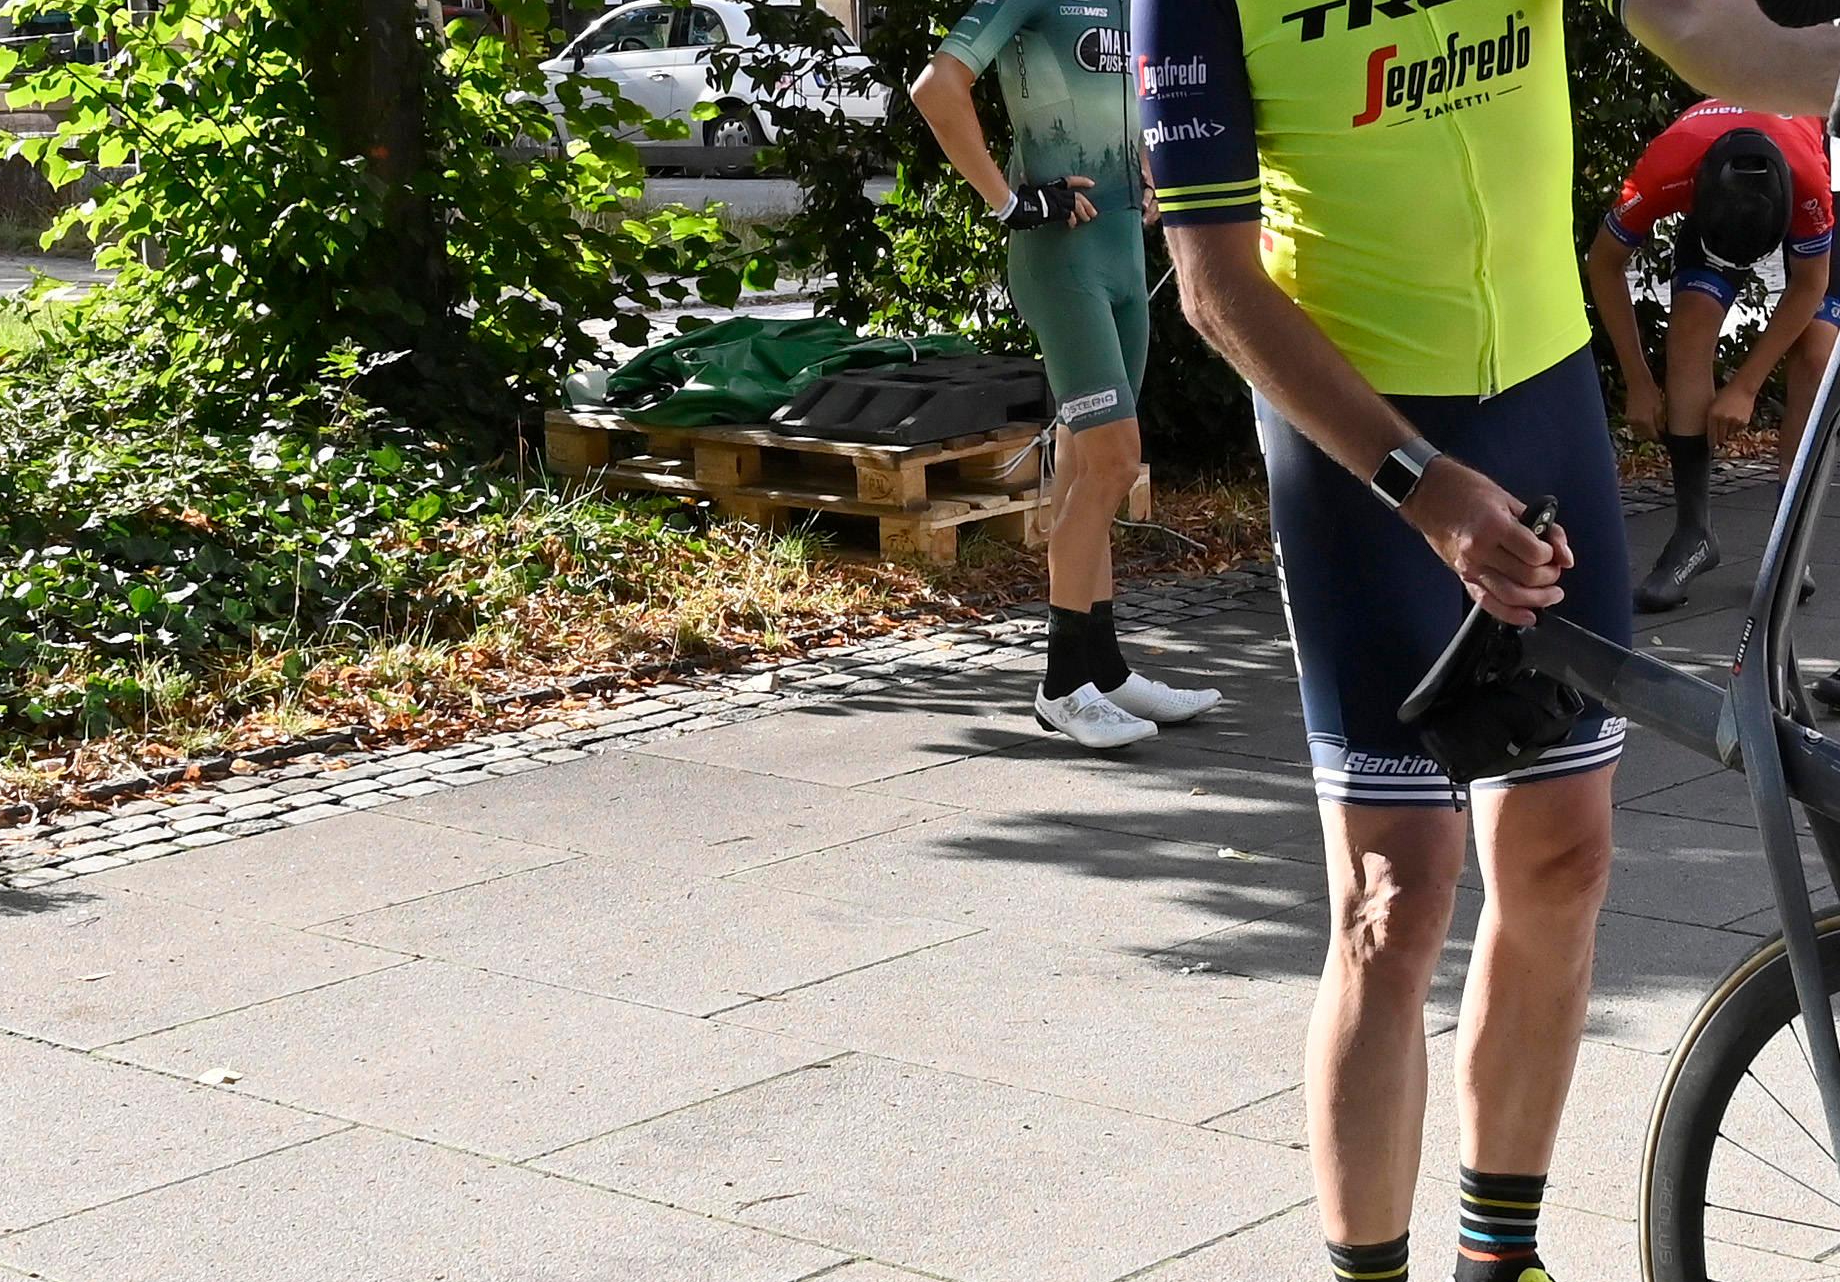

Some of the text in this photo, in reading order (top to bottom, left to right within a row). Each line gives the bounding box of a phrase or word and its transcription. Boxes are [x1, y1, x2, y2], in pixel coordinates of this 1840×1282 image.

[1138, 54, 1207, 96] Segafredo
[1352, 14, 1531, 128] Segafredo
[1423, 91, 1491, 120] ZANETTI
